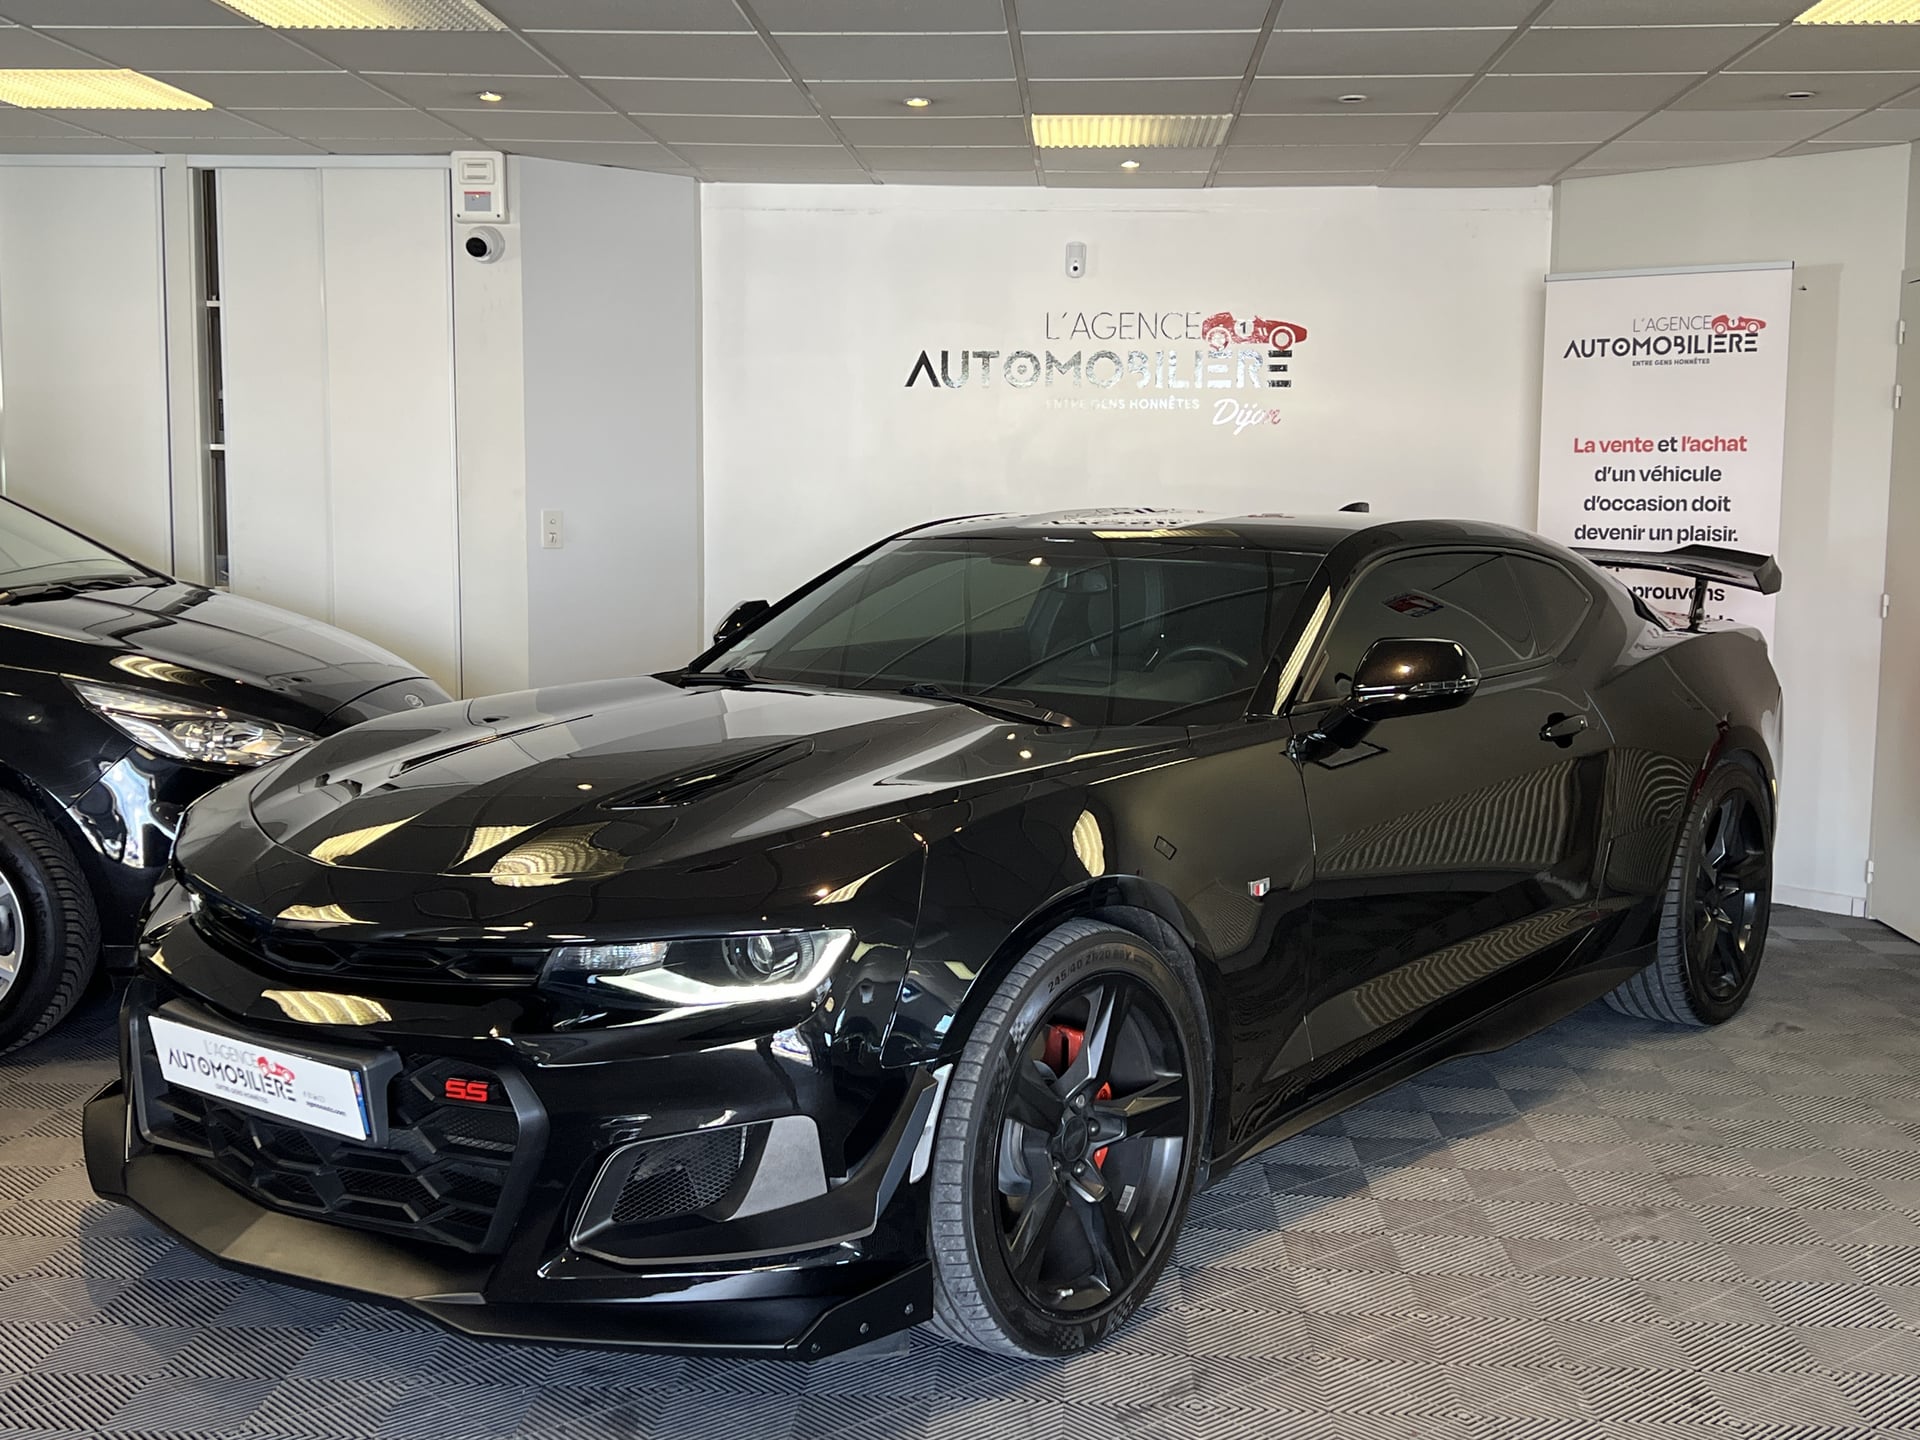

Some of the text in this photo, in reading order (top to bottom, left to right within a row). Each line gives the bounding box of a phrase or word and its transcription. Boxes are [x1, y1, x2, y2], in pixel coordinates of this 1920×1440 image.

[1045, 311, 1200, 340] L'AGENCE
[1239, 321, 1247, 335] 1
[1632, 315, 1712, 333] L'AGENCE
[1129, 395, 1200, 410] HONNÊTES
[1212, 398, 1281, 436] Dijon
[1574, 435, 1748, 453] La vente et l'achat
[1594, 465, 1722, 482] d'un véhicule
[1583, 495, 1731, 512] d'occasion doit
[1574, 524, 1738, 544] devenir un plaisir.
[445, 1077, 488, 1102] SS
